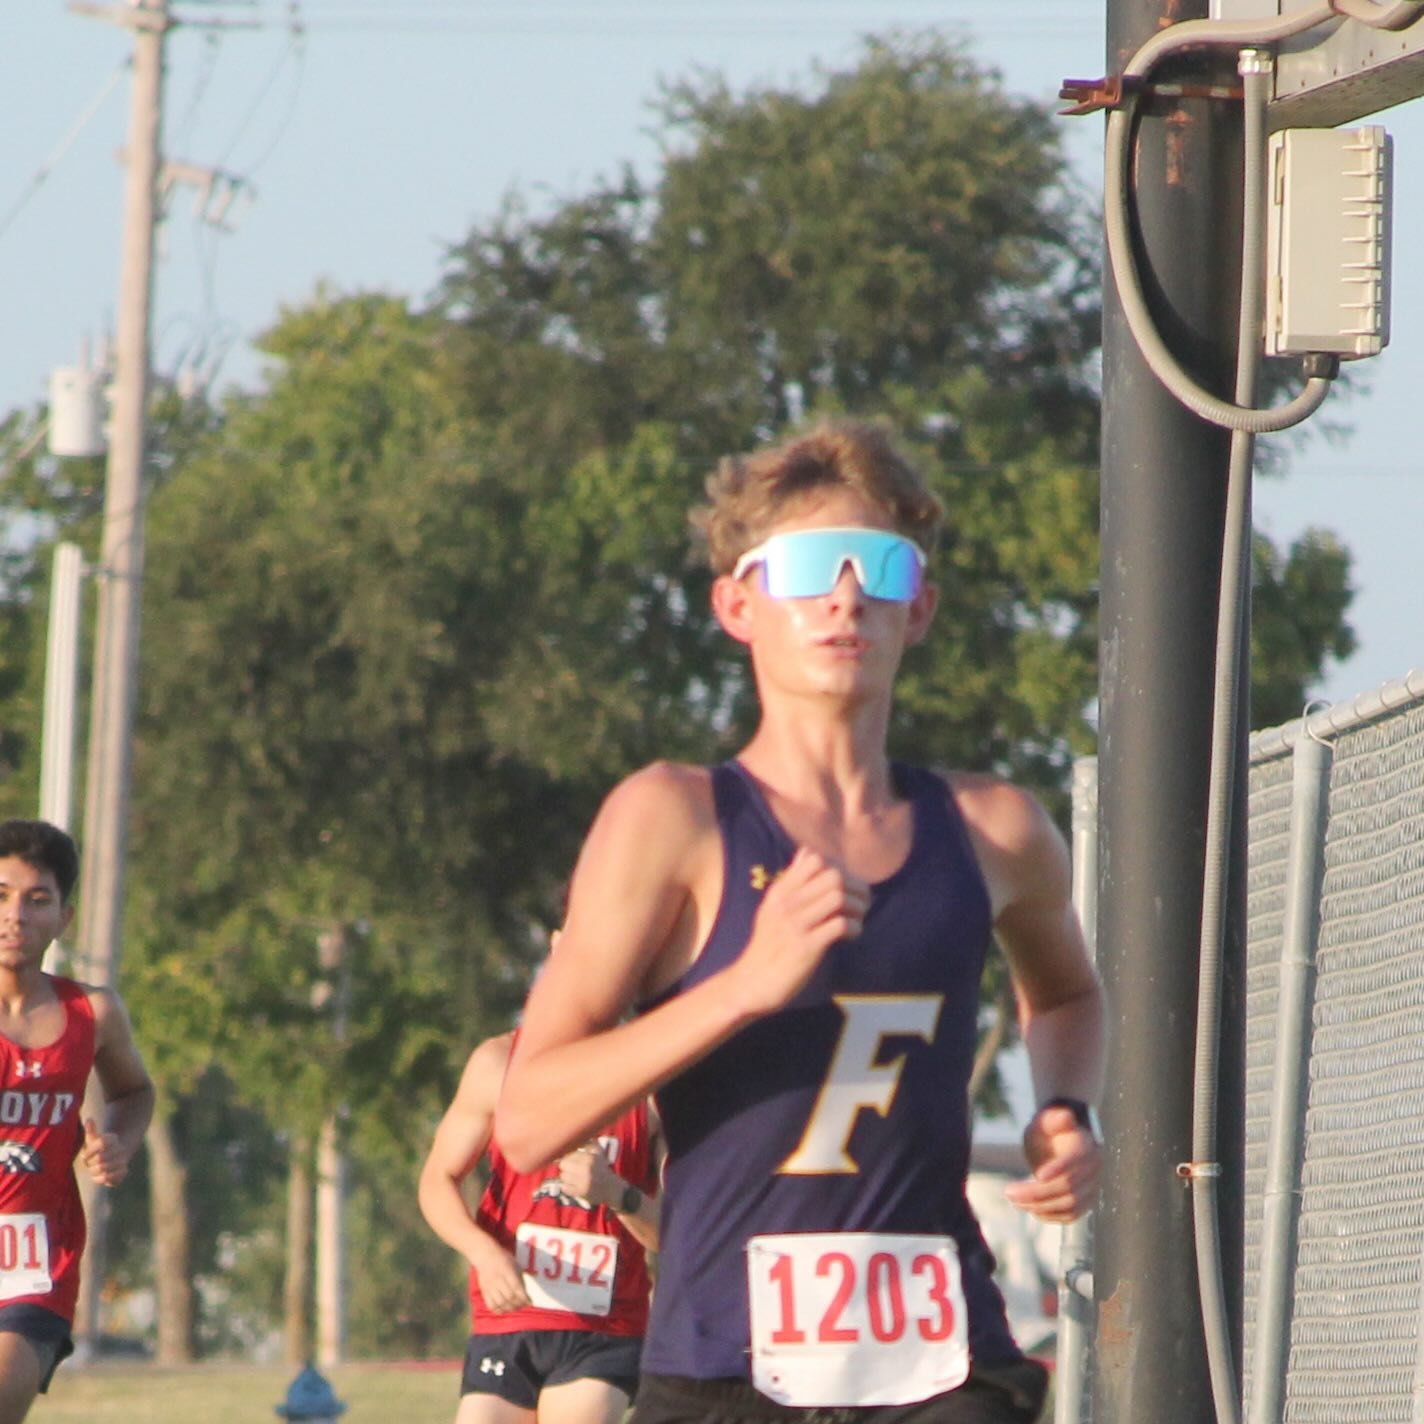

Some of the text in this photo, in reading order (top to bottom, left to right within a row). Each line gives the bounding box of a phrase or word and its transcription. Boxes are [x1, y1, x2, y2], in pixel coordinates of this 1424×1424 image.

[774, 993, 945, 1175] F
[526, 1234, 612, 1288] 1312
[768, 1251, 956, 1344] 1203
